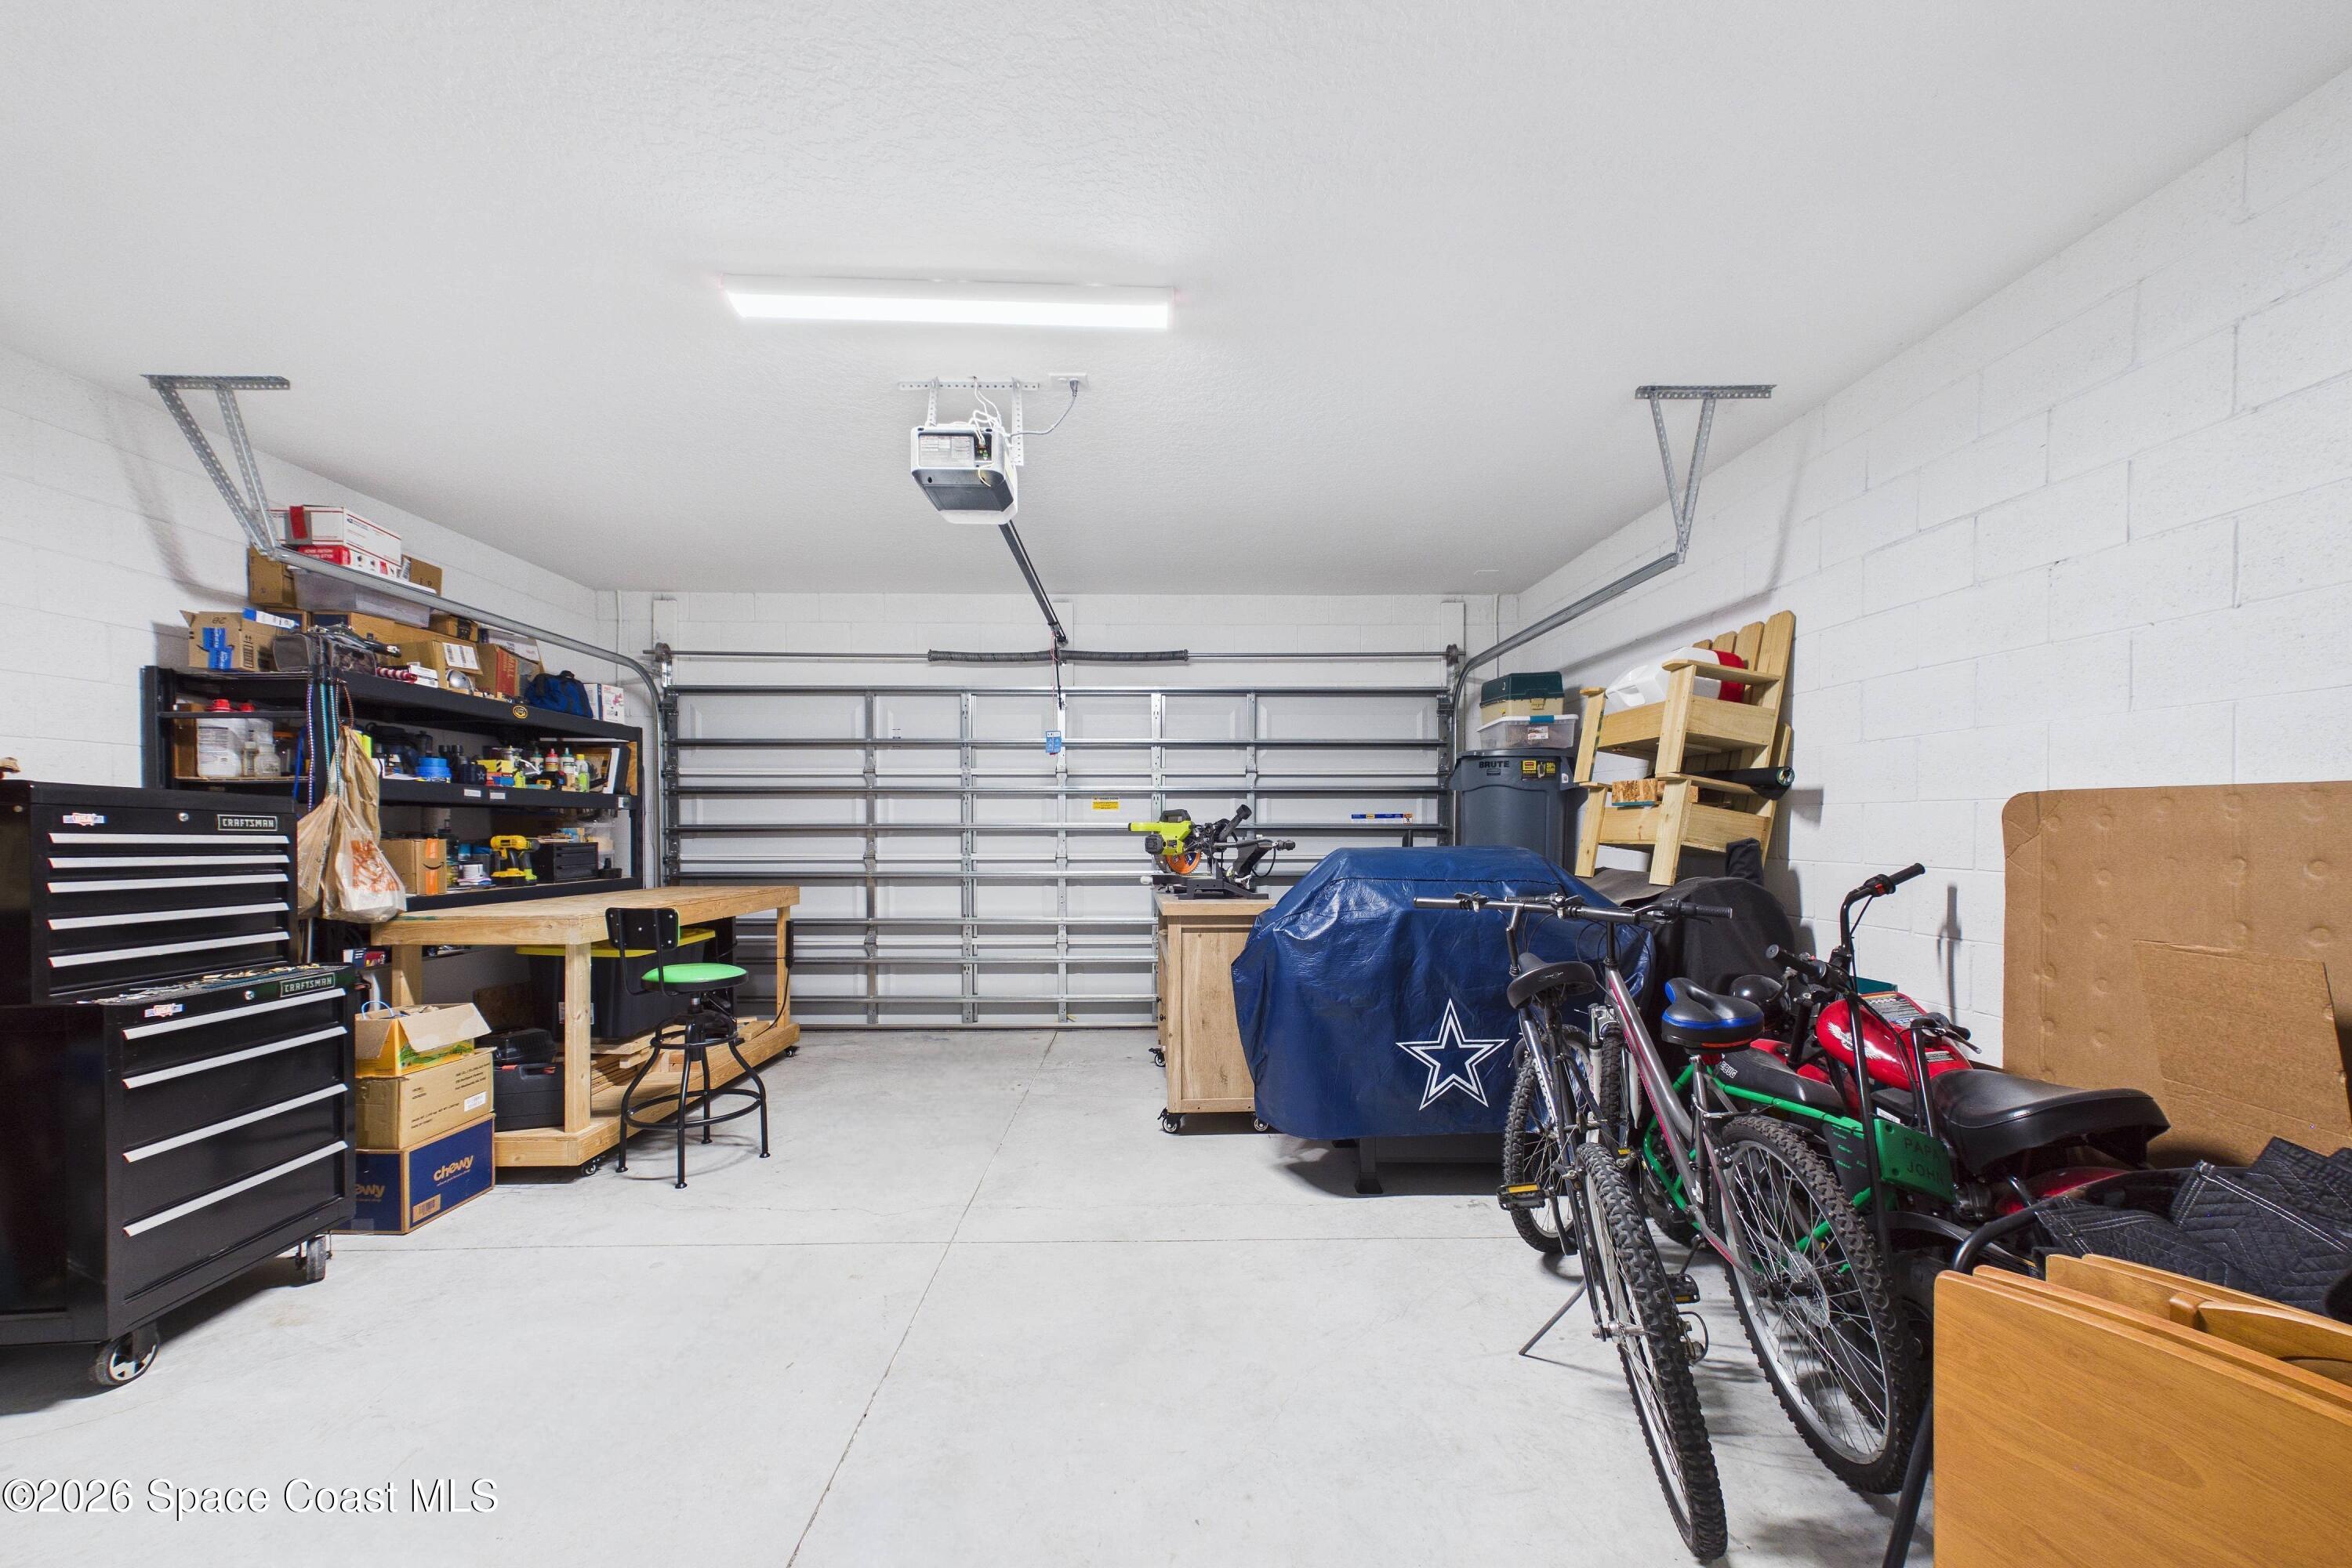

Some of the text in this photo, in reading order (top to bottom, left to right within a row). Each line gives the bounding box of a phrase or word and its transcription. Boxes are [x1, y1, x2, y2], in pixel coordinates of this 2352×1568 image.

[223, 818, 274, 827] CRAFTSMAN
[285, 978, 332, 993] CRAFTSMAN
[1904, 1138, 1940, 1160] PAPA
[434, 1155, 474, 1181] chewy
[1907, 1162, 1944, 1185] JOHN
[354, 1184, 385, 1198] ewy
